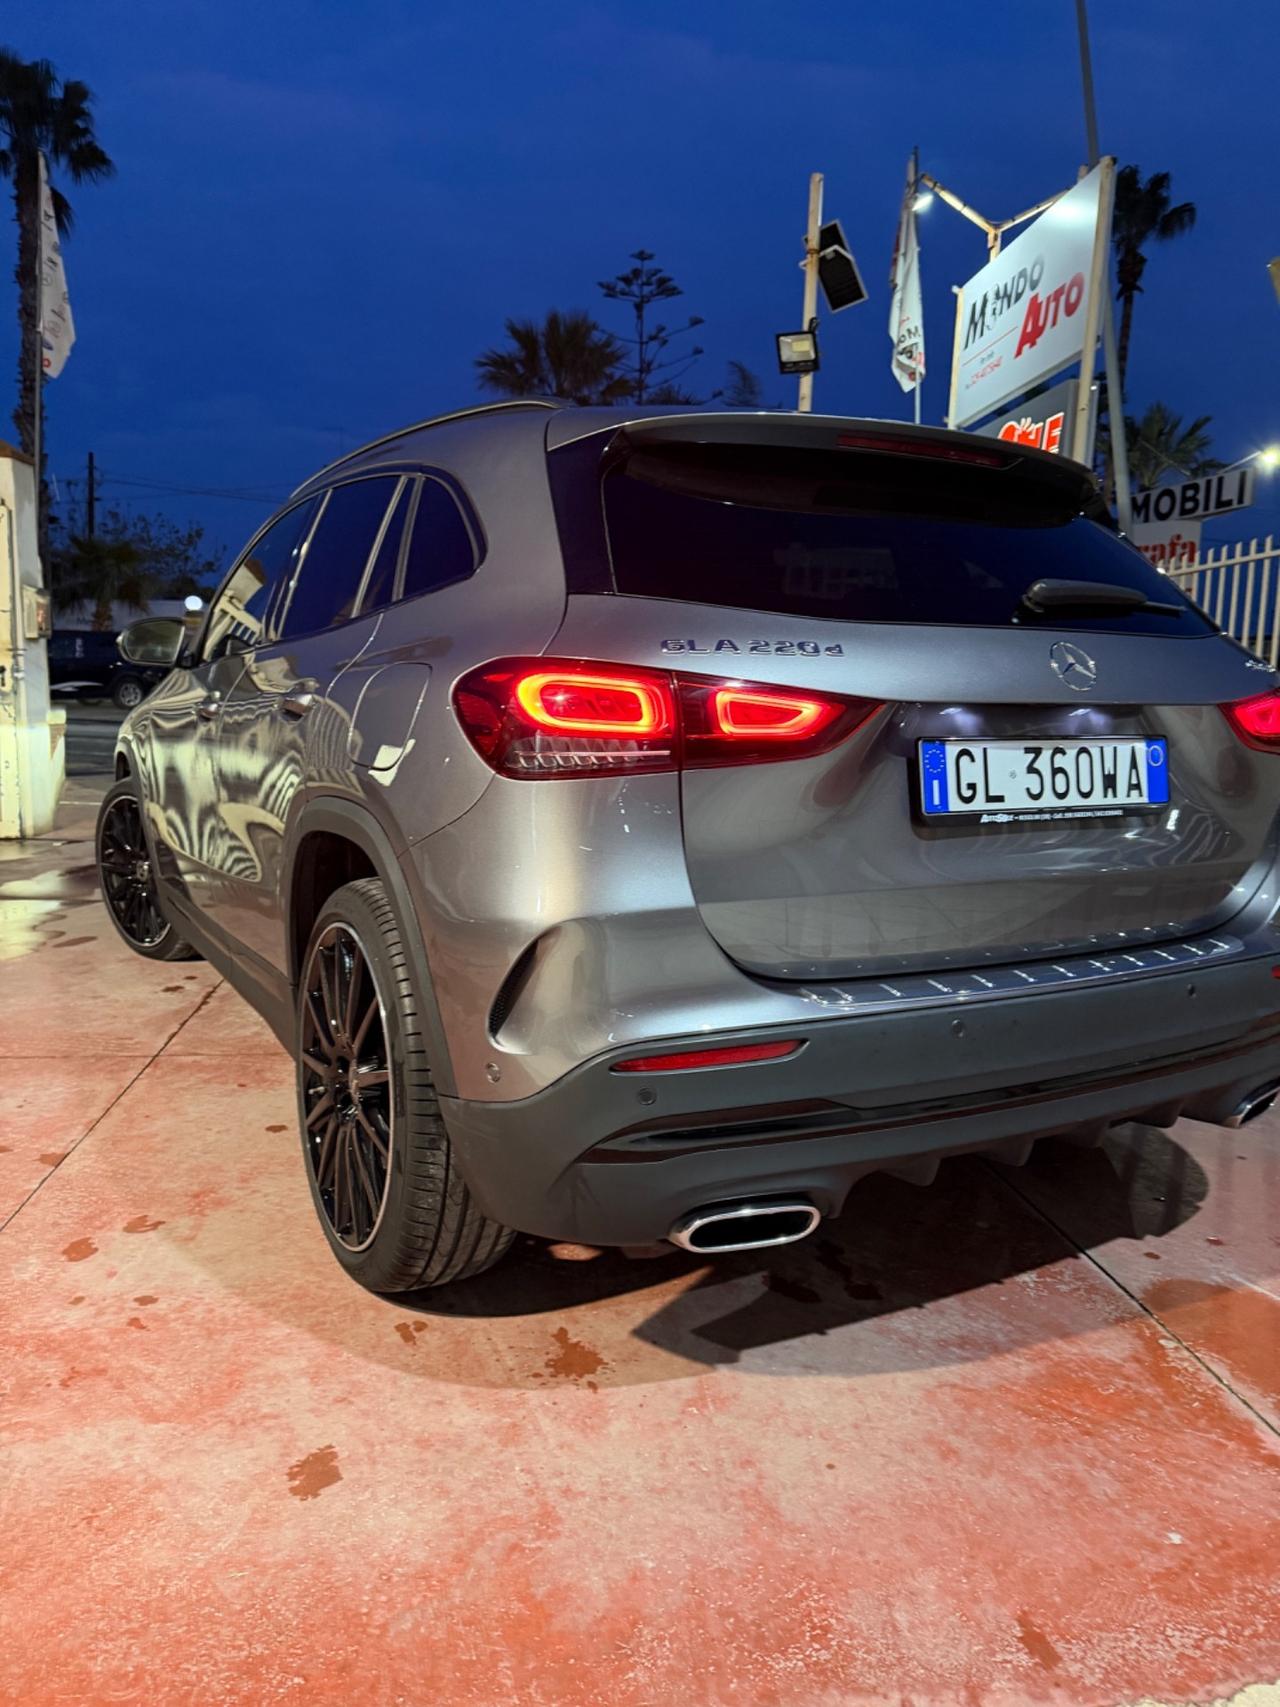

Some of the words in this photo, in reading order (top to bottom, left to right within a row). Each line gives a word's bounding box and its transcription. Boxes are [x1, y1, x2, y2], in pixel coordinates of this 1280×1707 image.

[1014, 271, 1085, 359] AUTO
[1130, 470, 1247, 523] MOBILI
[955, 746, 1005, 804] GL
[1023, 745, 1143, 801] 360WA
